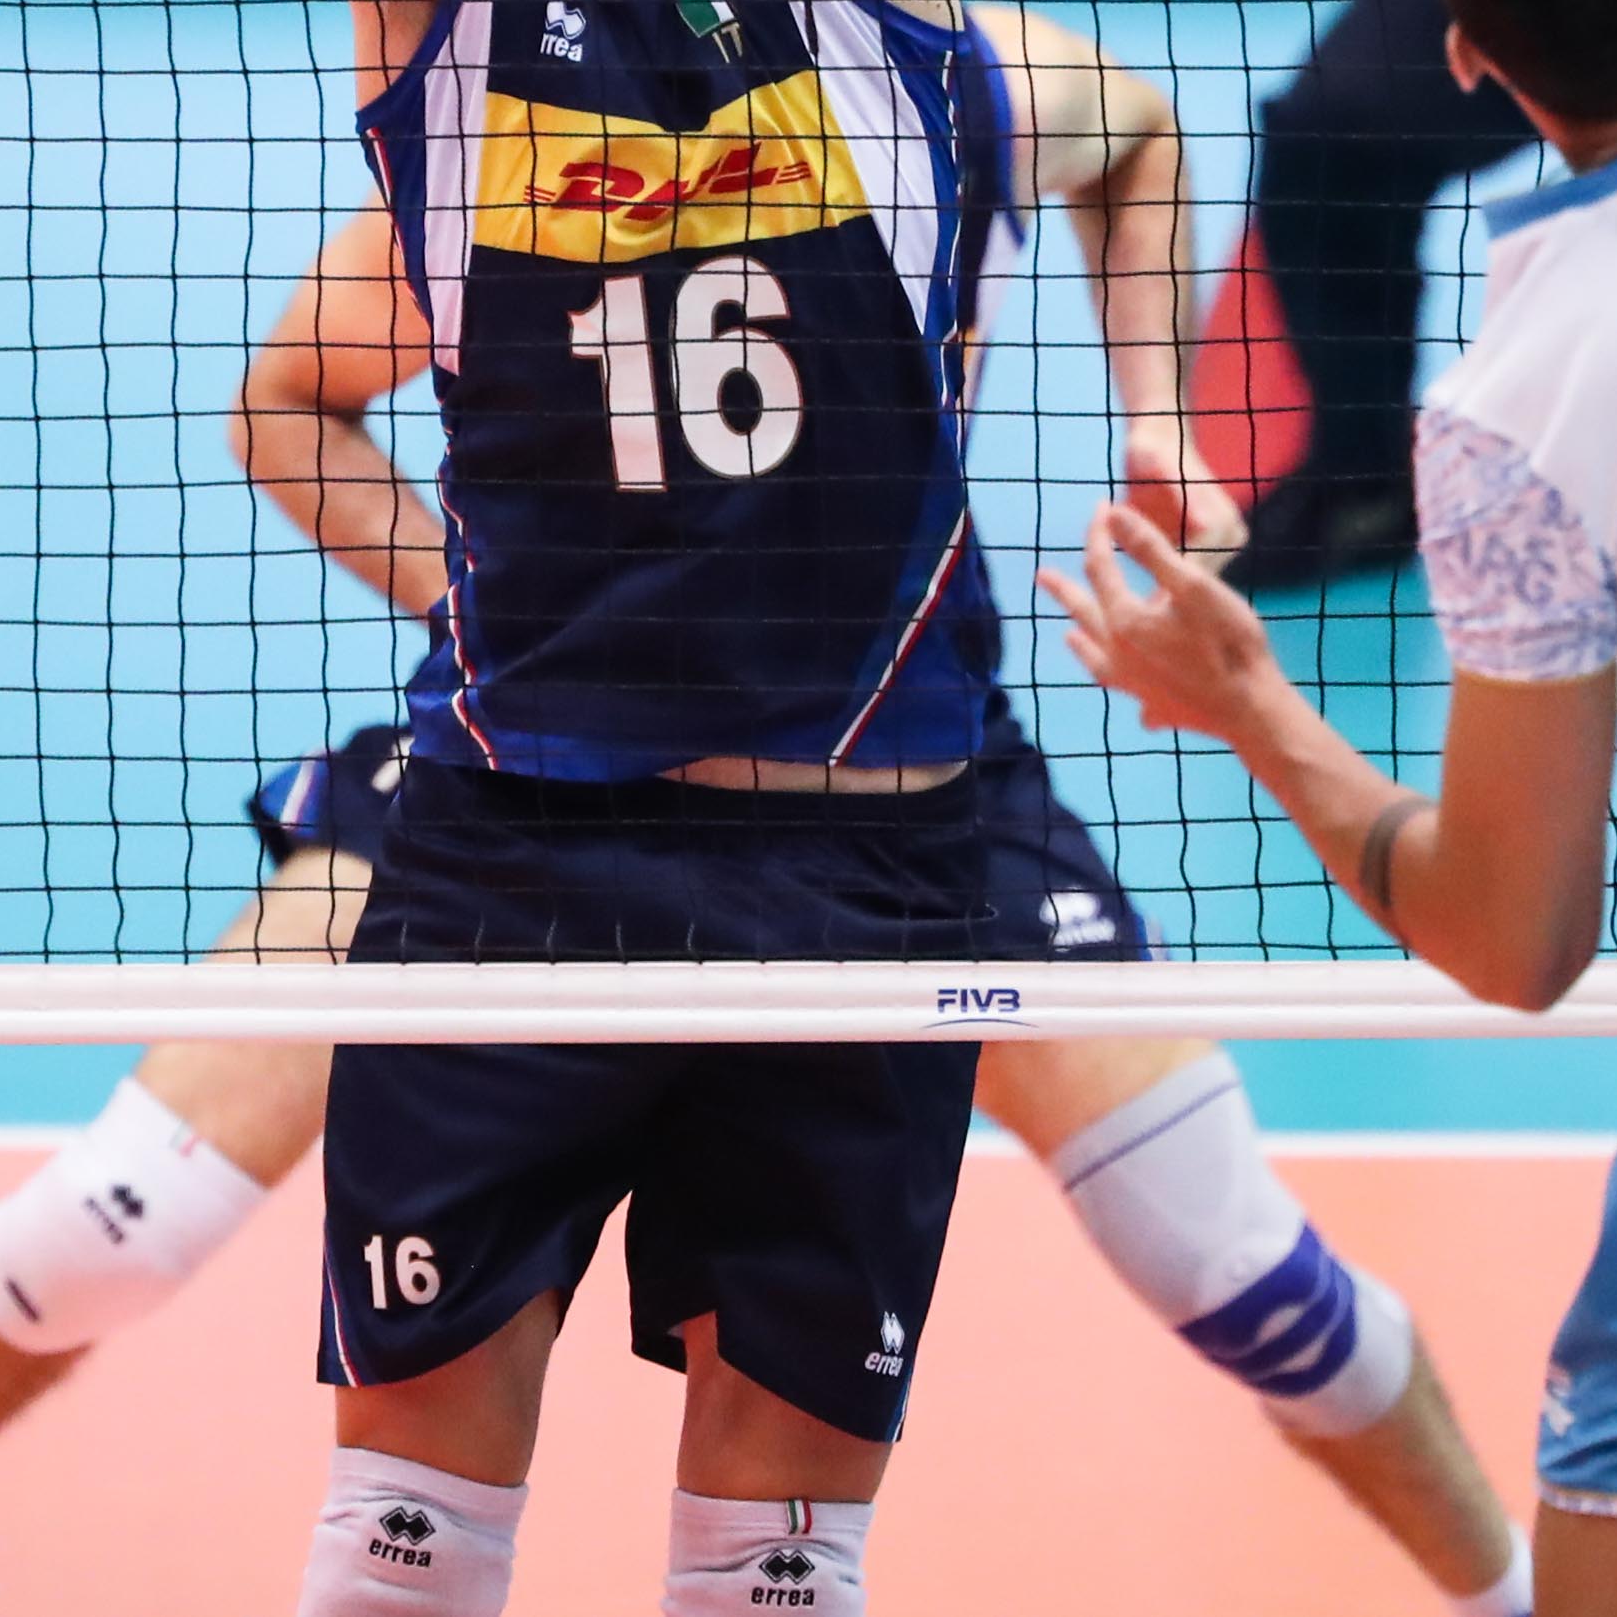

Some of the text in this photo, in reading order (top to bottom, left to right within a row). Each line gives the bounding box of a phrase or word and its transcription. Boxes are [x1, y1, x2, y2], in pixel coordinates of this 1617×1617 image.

[540, 33, 582, 62] rrea
[567, 254, 804, 492] 16
[937, 988, 1021, 1013] FIVB
[364, 1235, 440, 1310] 16
[864, 1352, 904, 1377] errea
[368, 1538, 432, 1568] errea
[751, 1586, 815, 1606] errea
